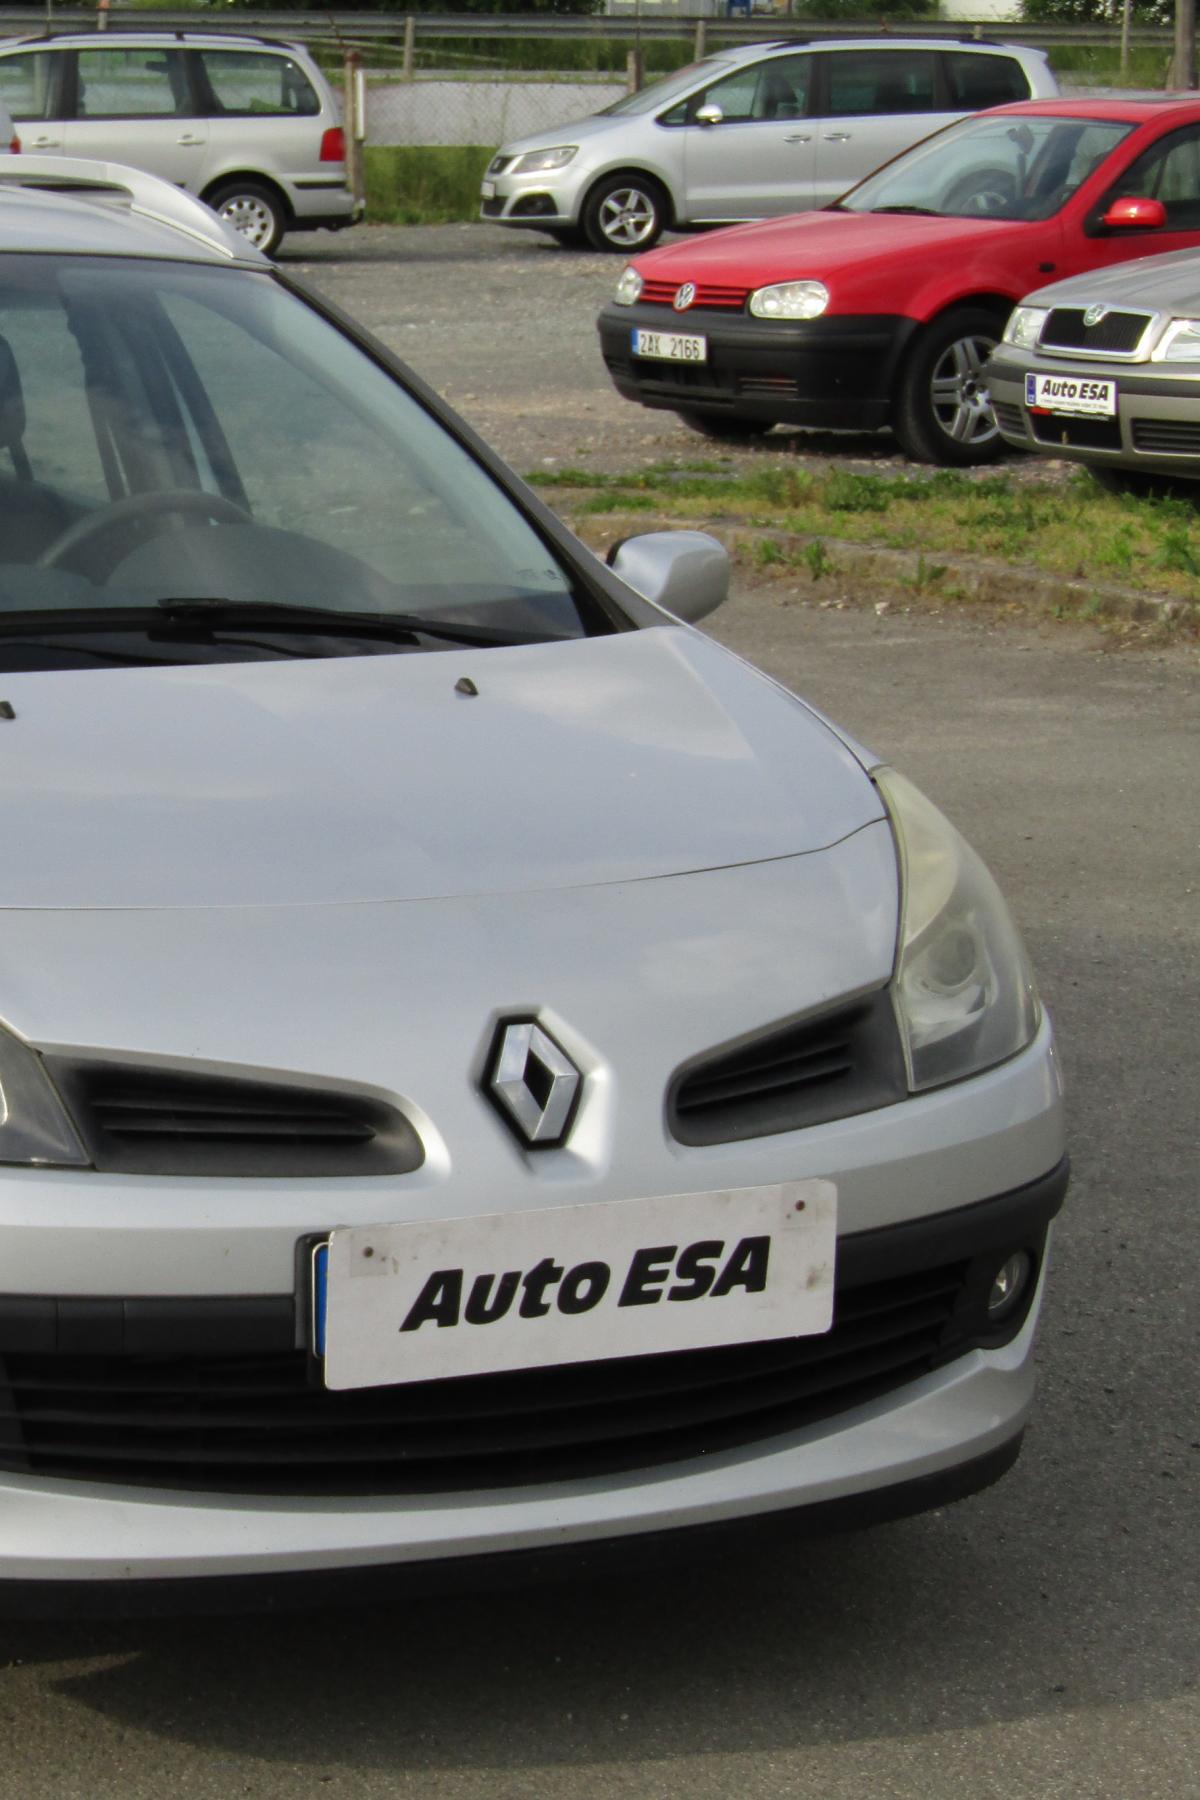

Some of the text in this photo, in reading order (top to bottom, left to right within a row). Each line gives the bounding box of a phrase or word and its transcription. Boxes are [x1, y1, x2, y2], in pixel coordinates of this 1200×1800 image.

[670, 337, 700, 360] 2166
[1041, 379, 1078, 399] Auto
[1079, 382, 1109, 401] ESA
[399, 1235, 771, 1333] Auto ESA
